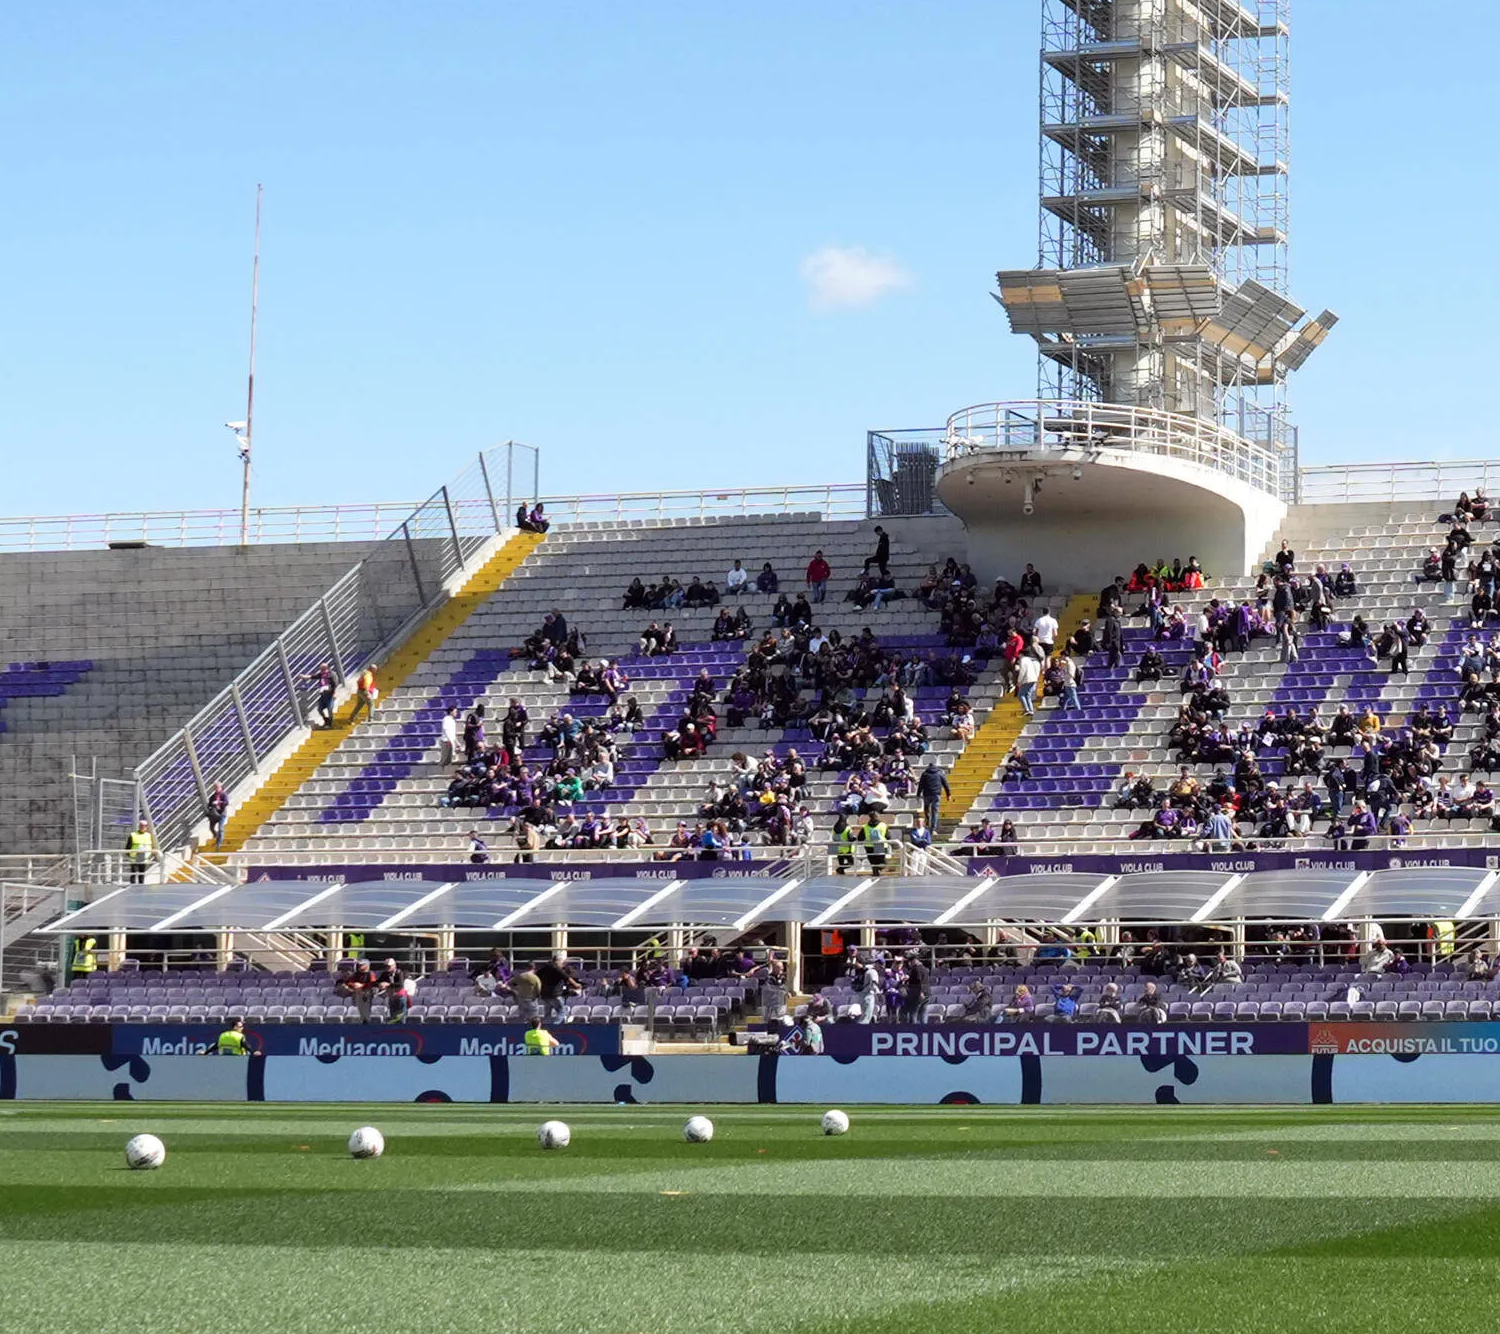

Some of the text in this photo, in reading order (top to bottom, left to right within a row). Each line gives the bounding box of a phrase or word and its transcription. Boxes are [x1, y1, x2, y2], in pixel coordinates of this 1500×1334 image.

[1030, 864, 1072, 874] VIOLA CLUB
[1120, 862, 1163, 873] VIOLA CLUB
[1211, 861, 1255, 872] VIOLA CLUB
[1310, 860, 1355, 870] VIOLA CLUB
[384, 872, 422, 881] VIOLA CLUB
[466, 871, 506, 881] VIOLA CLUB
[551, 871, 590, 880] VIOLA CLUB
[636, 870, 677, 879] VIOLA CLUB
[299, 1036, 411, 1055] Mediacom
[460, 1037, 575, 1056] Mediam
[871, 1031, 1254, 1056] PRINCIPAL PARTNER
[1346, 1038, 1437, 1053] ACQUISTA
[1440, 1038, 1458, 1053] IL
[1459, 1038, 1498, 1053] TUO
